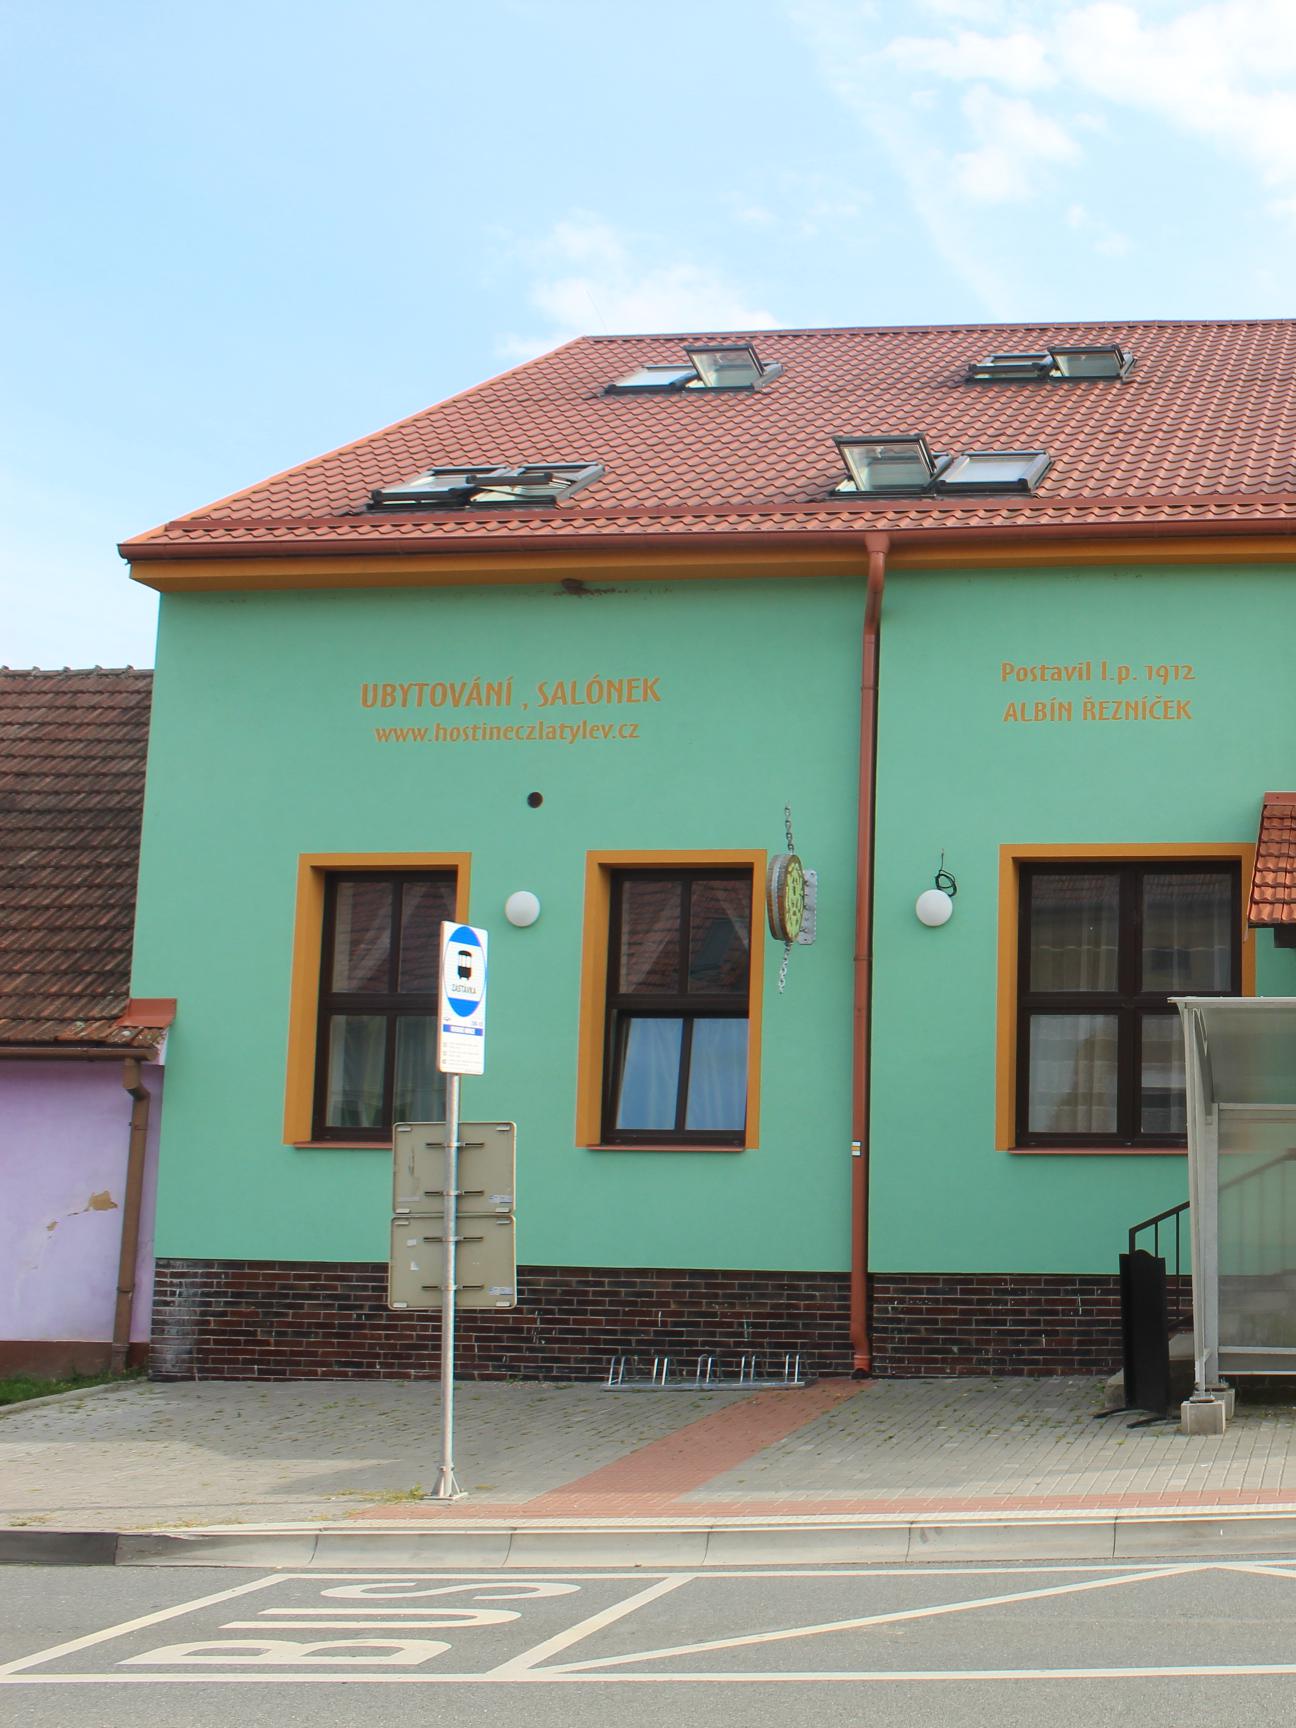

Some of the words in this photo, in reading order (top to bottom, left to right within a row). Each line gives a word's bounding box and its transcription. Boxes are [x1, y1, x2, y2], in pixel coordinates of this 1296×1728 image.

[1001, 660, 1091, 682] Postavil
[1144, 664, 1195, 685] 1912
[361, 676, 514, 708] UBYTOVÁNÍ
[537, 674, 661, 707] SALÓNEK
[1003, 696, 1073, 722] ALBÍN
[1082, 695, 1193, 721] ŘEZNÍČEK
[375, 719, 640, 744] www.hostineczlatylev.cz
[115, 1581, 582, 1666] BUS
